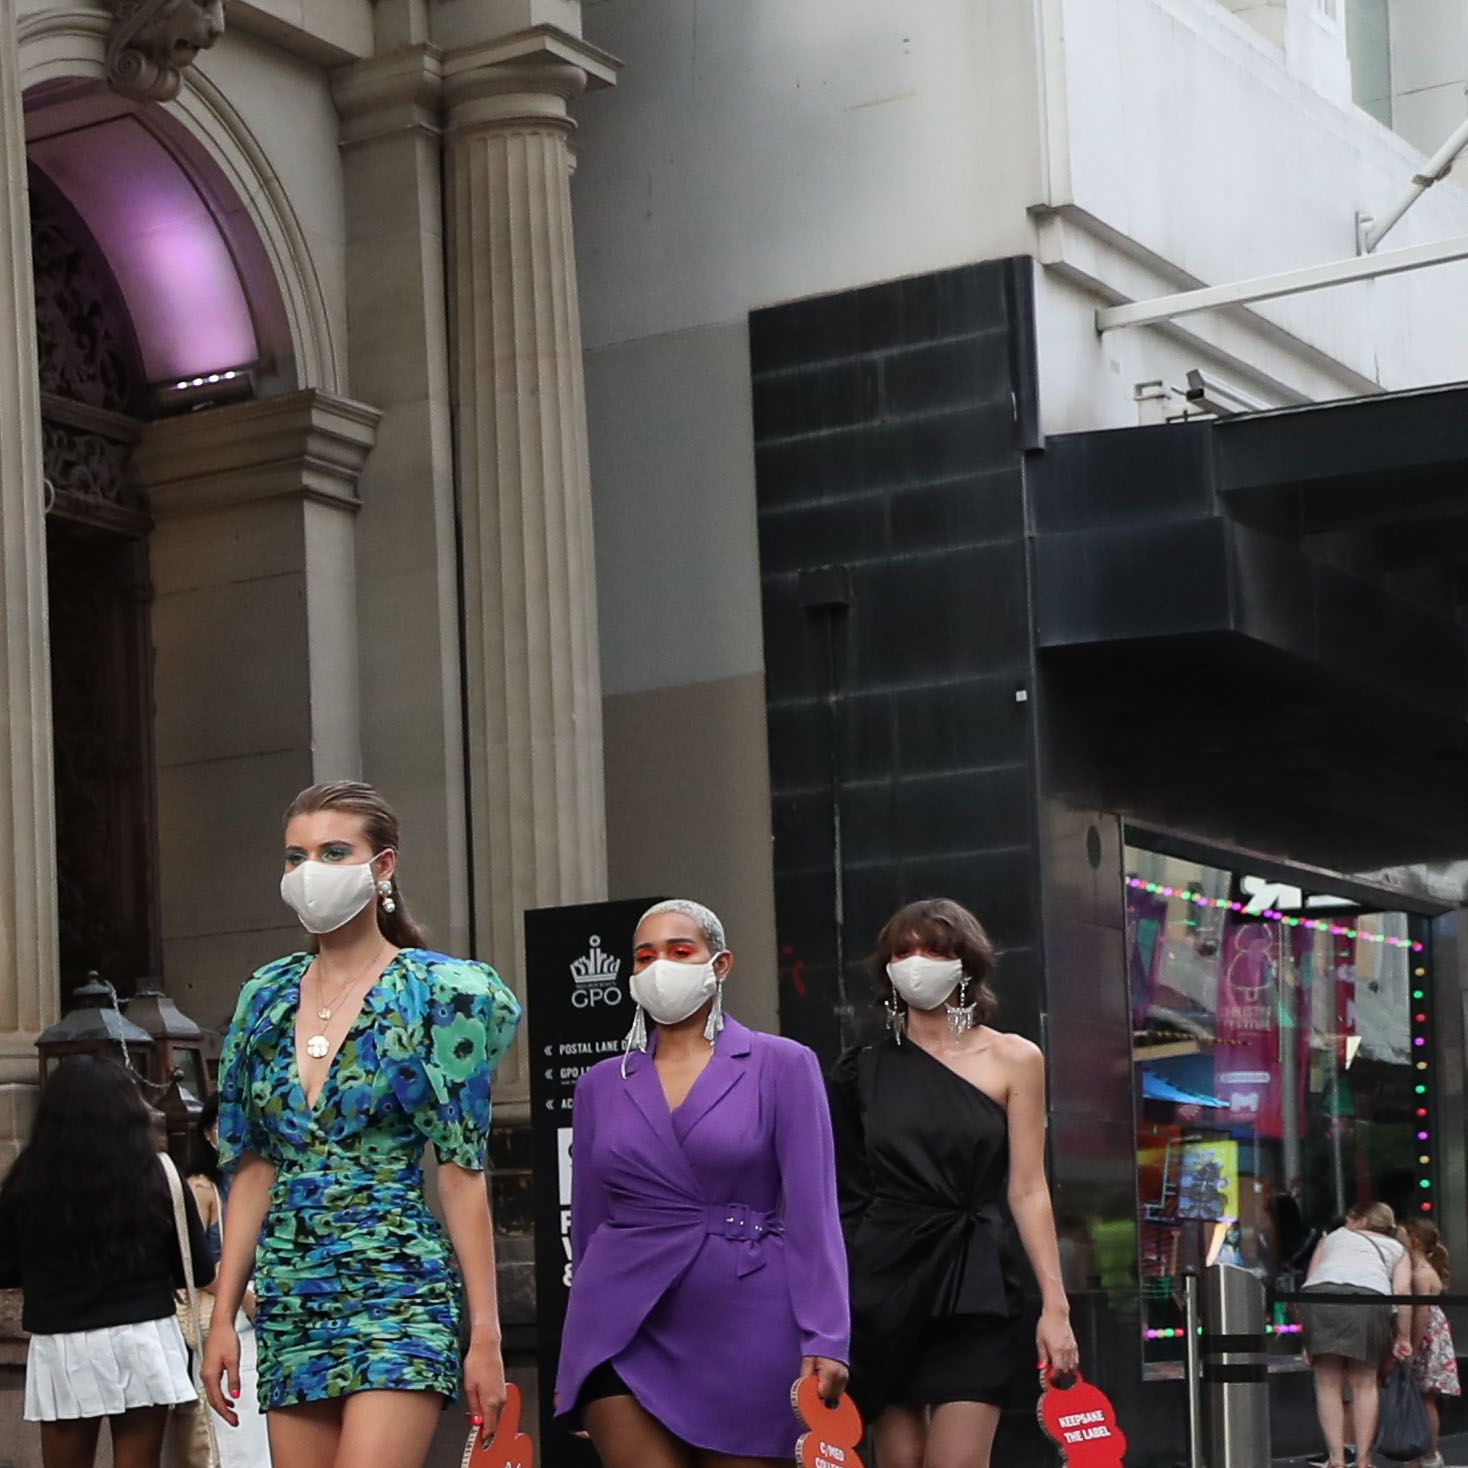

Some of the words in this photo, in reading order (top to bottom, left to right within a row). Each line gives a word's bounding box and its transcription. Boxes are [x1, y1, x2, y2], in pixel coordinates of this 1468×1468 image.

[571, 986, 622, 1008] GPO
[560, 1042, 592, 1055] POSTAL
[596, 1040, 618, 1053] LANE
[560, 1066, 578, 1079] GPO
[1058, 1410, 1105, 1428] KEEPSAKE
[1064, 1430, 1084, 1443] THE
[1082, 1425, 1111, 1440] LABEL
